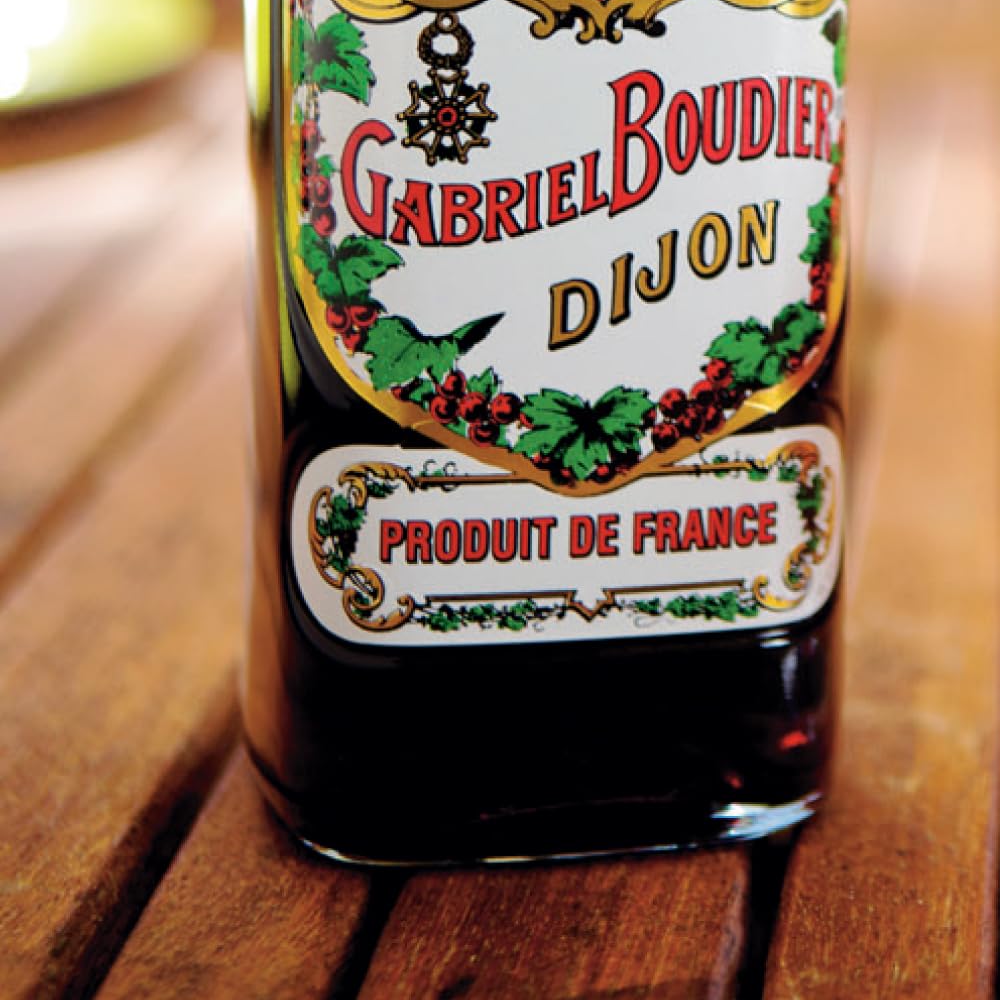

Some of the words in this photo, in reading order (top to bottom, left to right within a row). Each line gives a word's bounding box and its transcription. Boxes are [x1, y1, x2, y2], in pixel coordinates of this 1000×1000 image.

[340, 119, 609, 247] GABRIEL
[608, 68, 834, 218] BOUDIER
[547, 199, 781, 351] DIJON
[380, 516, 557, 564] PRODUIT
[569, 512, 620, 559] DE
[632, 501, 778, 555] FRANCE
